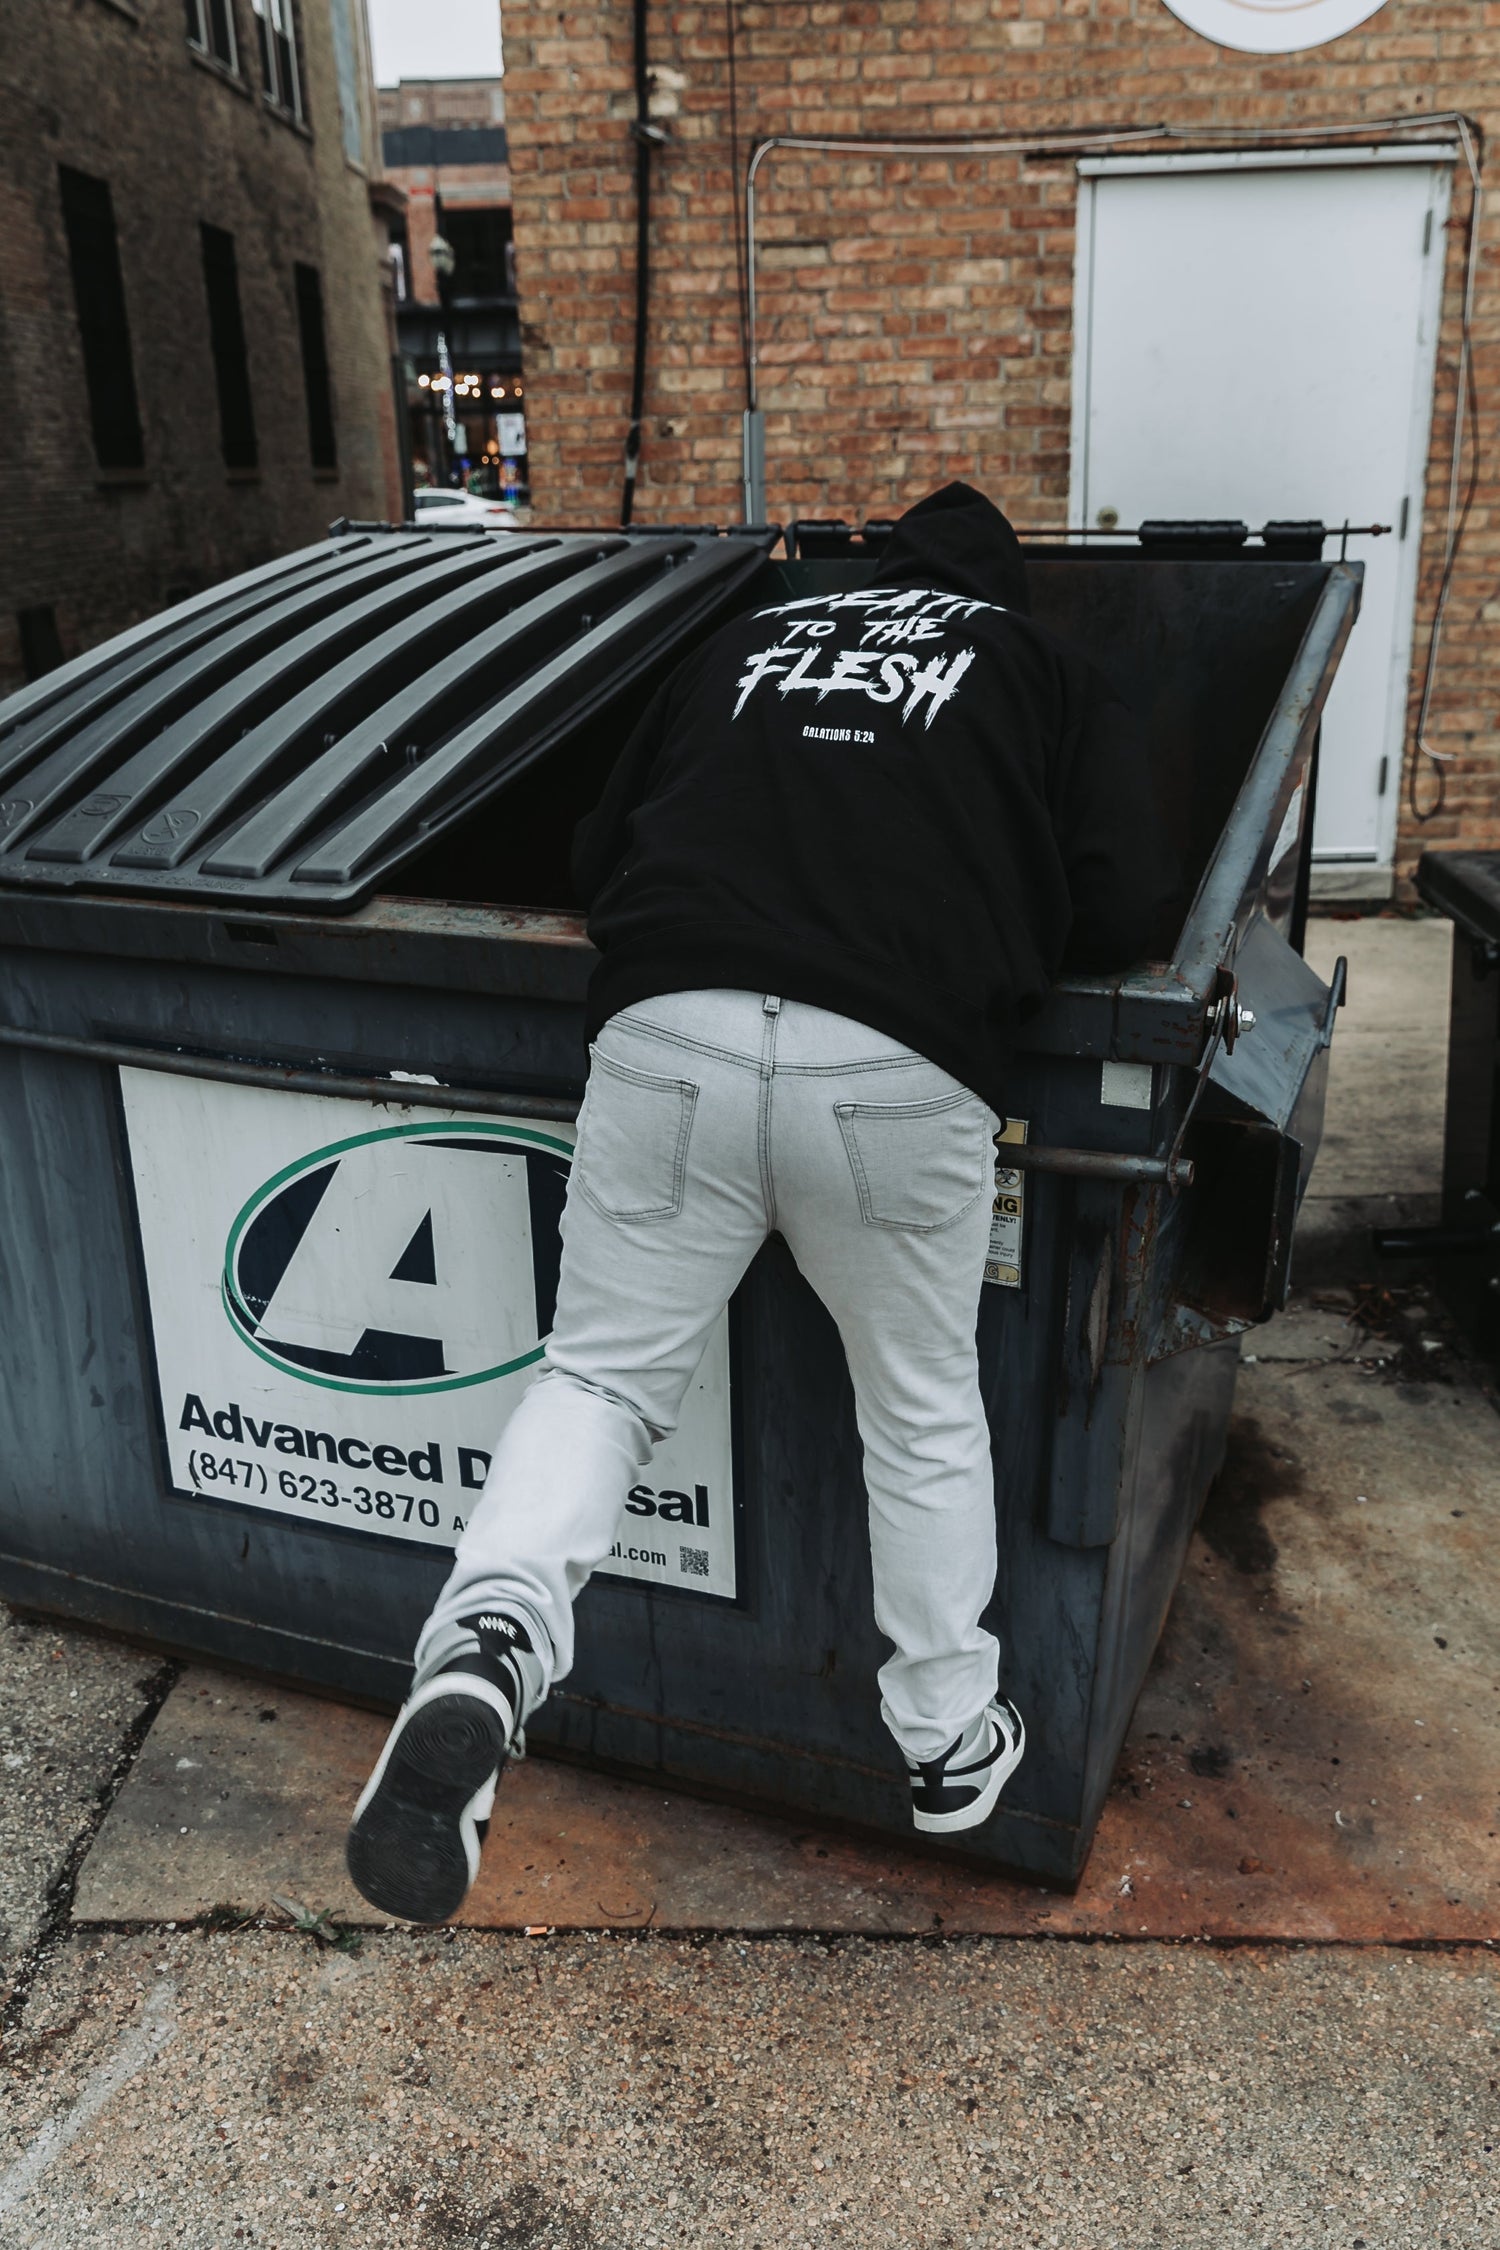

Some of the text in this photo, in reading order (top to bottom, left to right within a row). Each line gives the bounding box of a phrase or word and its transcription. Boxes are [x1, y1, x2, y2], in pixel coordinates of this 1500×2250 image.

[781, 614, 949, 647] TO THE
[731, 645, 977, 731] FLESH
[802, 725, 875, 743] GALATIONS 5:24
[179, 1392, 444, 1484] Advanced
[188, 1449, 440, 1527] (847) 623-3870
[478, 1616, 518, 1640] NIKE
